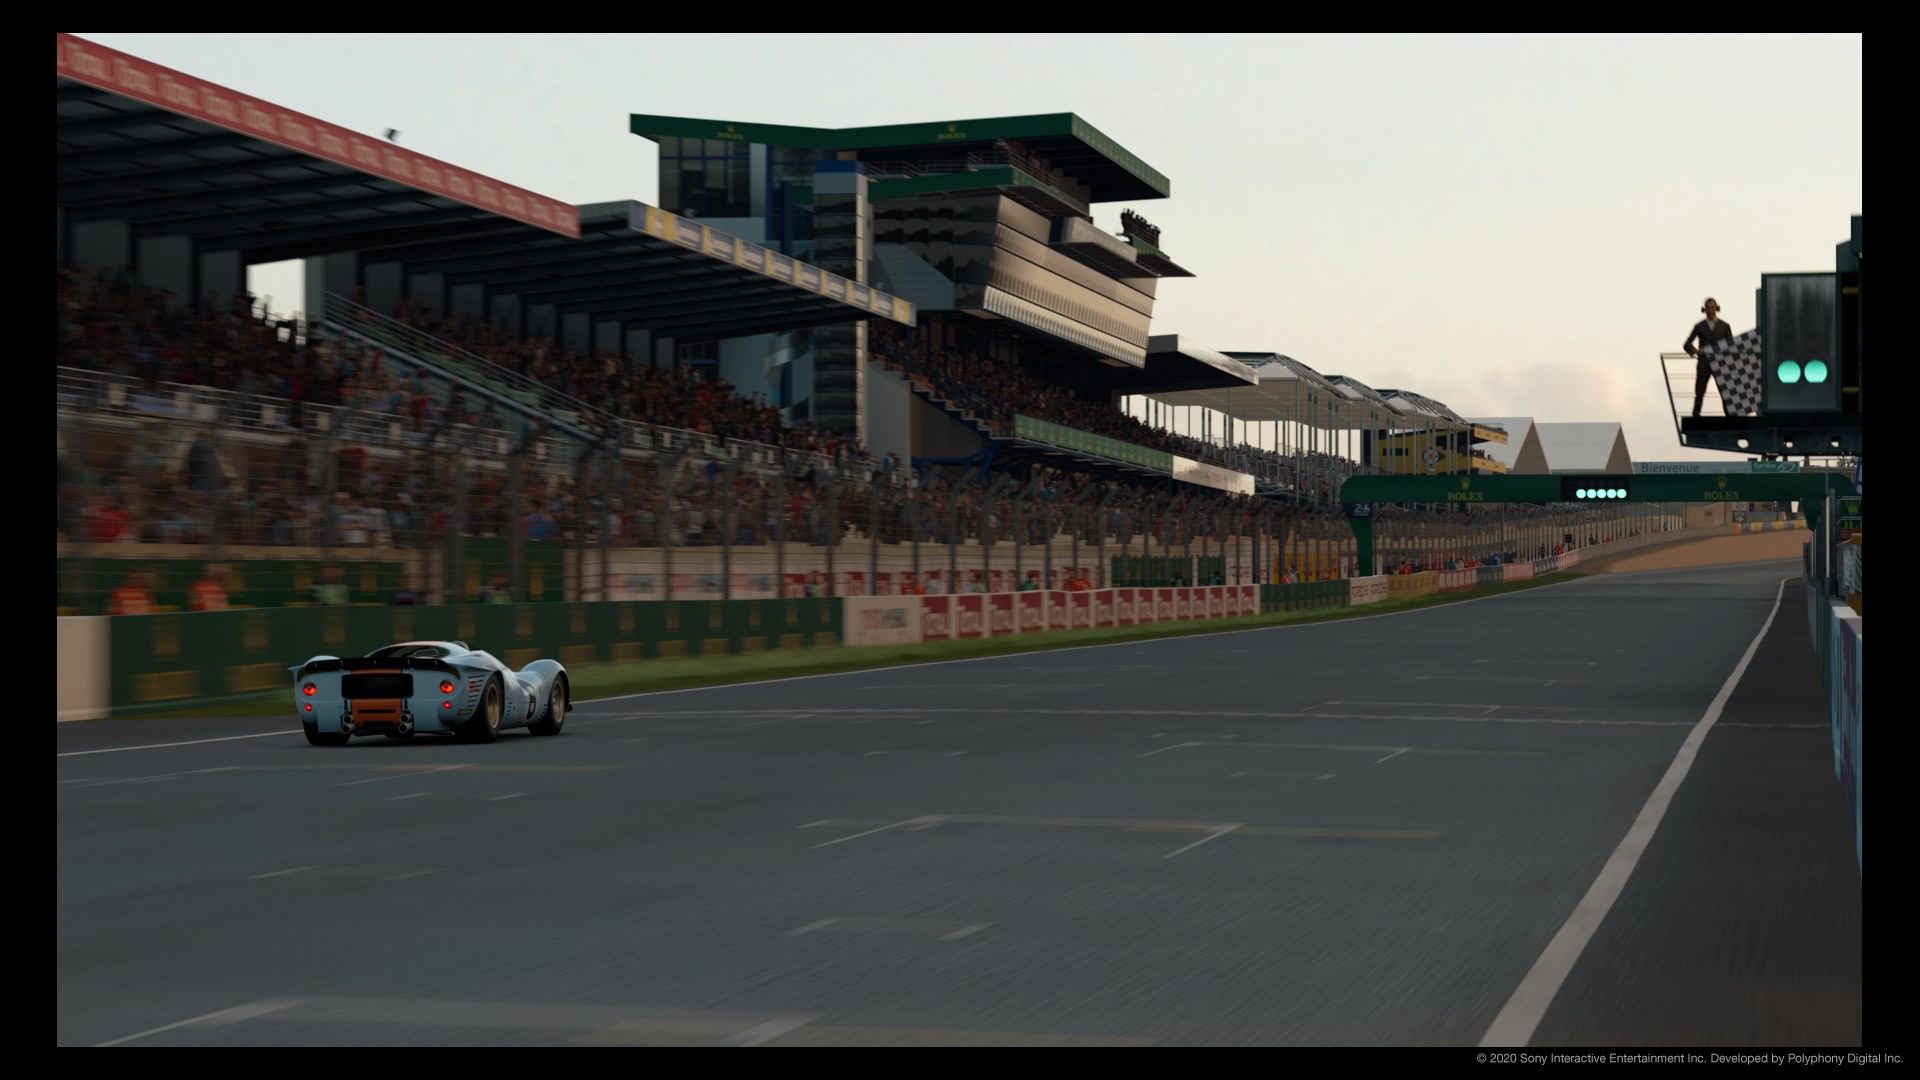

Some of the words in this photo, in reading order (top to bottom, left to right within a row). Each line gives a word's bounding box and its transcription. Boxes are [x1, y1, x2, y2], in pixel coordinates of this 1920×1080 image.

[1641, 463, 1699, 473] Bienvenue
[1447, 491, 1485, 501] ROLEX
[1704, 491, 1741, 501] ROLEX
